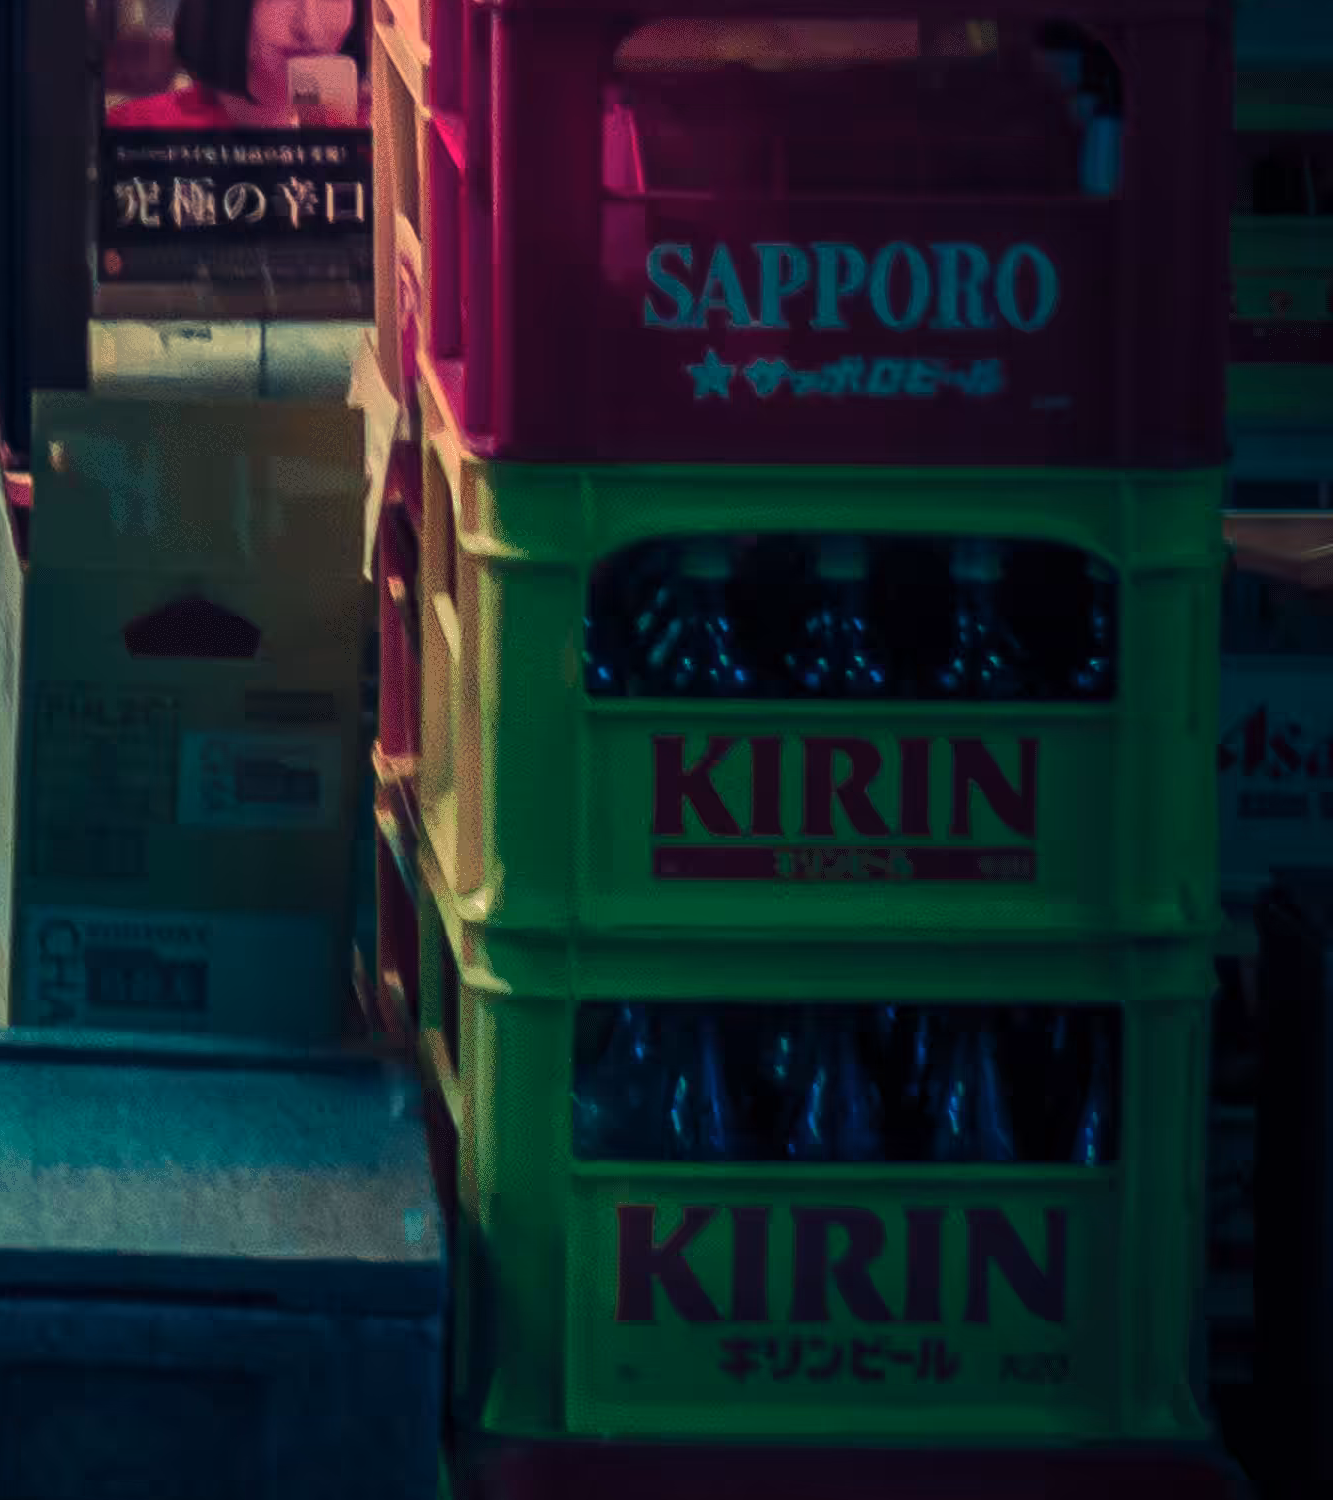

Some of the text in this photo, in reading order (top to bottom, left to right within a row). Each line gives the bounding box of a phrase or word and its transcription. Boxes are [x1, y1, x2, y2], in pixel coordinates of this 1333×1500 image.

[112, 175, 366, 232] 究極の辛口
[641, 239, 1062, 333] SAPPORO
[650, 733, 1040, 840] KIRIN
[612, 1202, 1069, 1325] KIRIN
[717, 1336, 961, 1384] キリンビール
